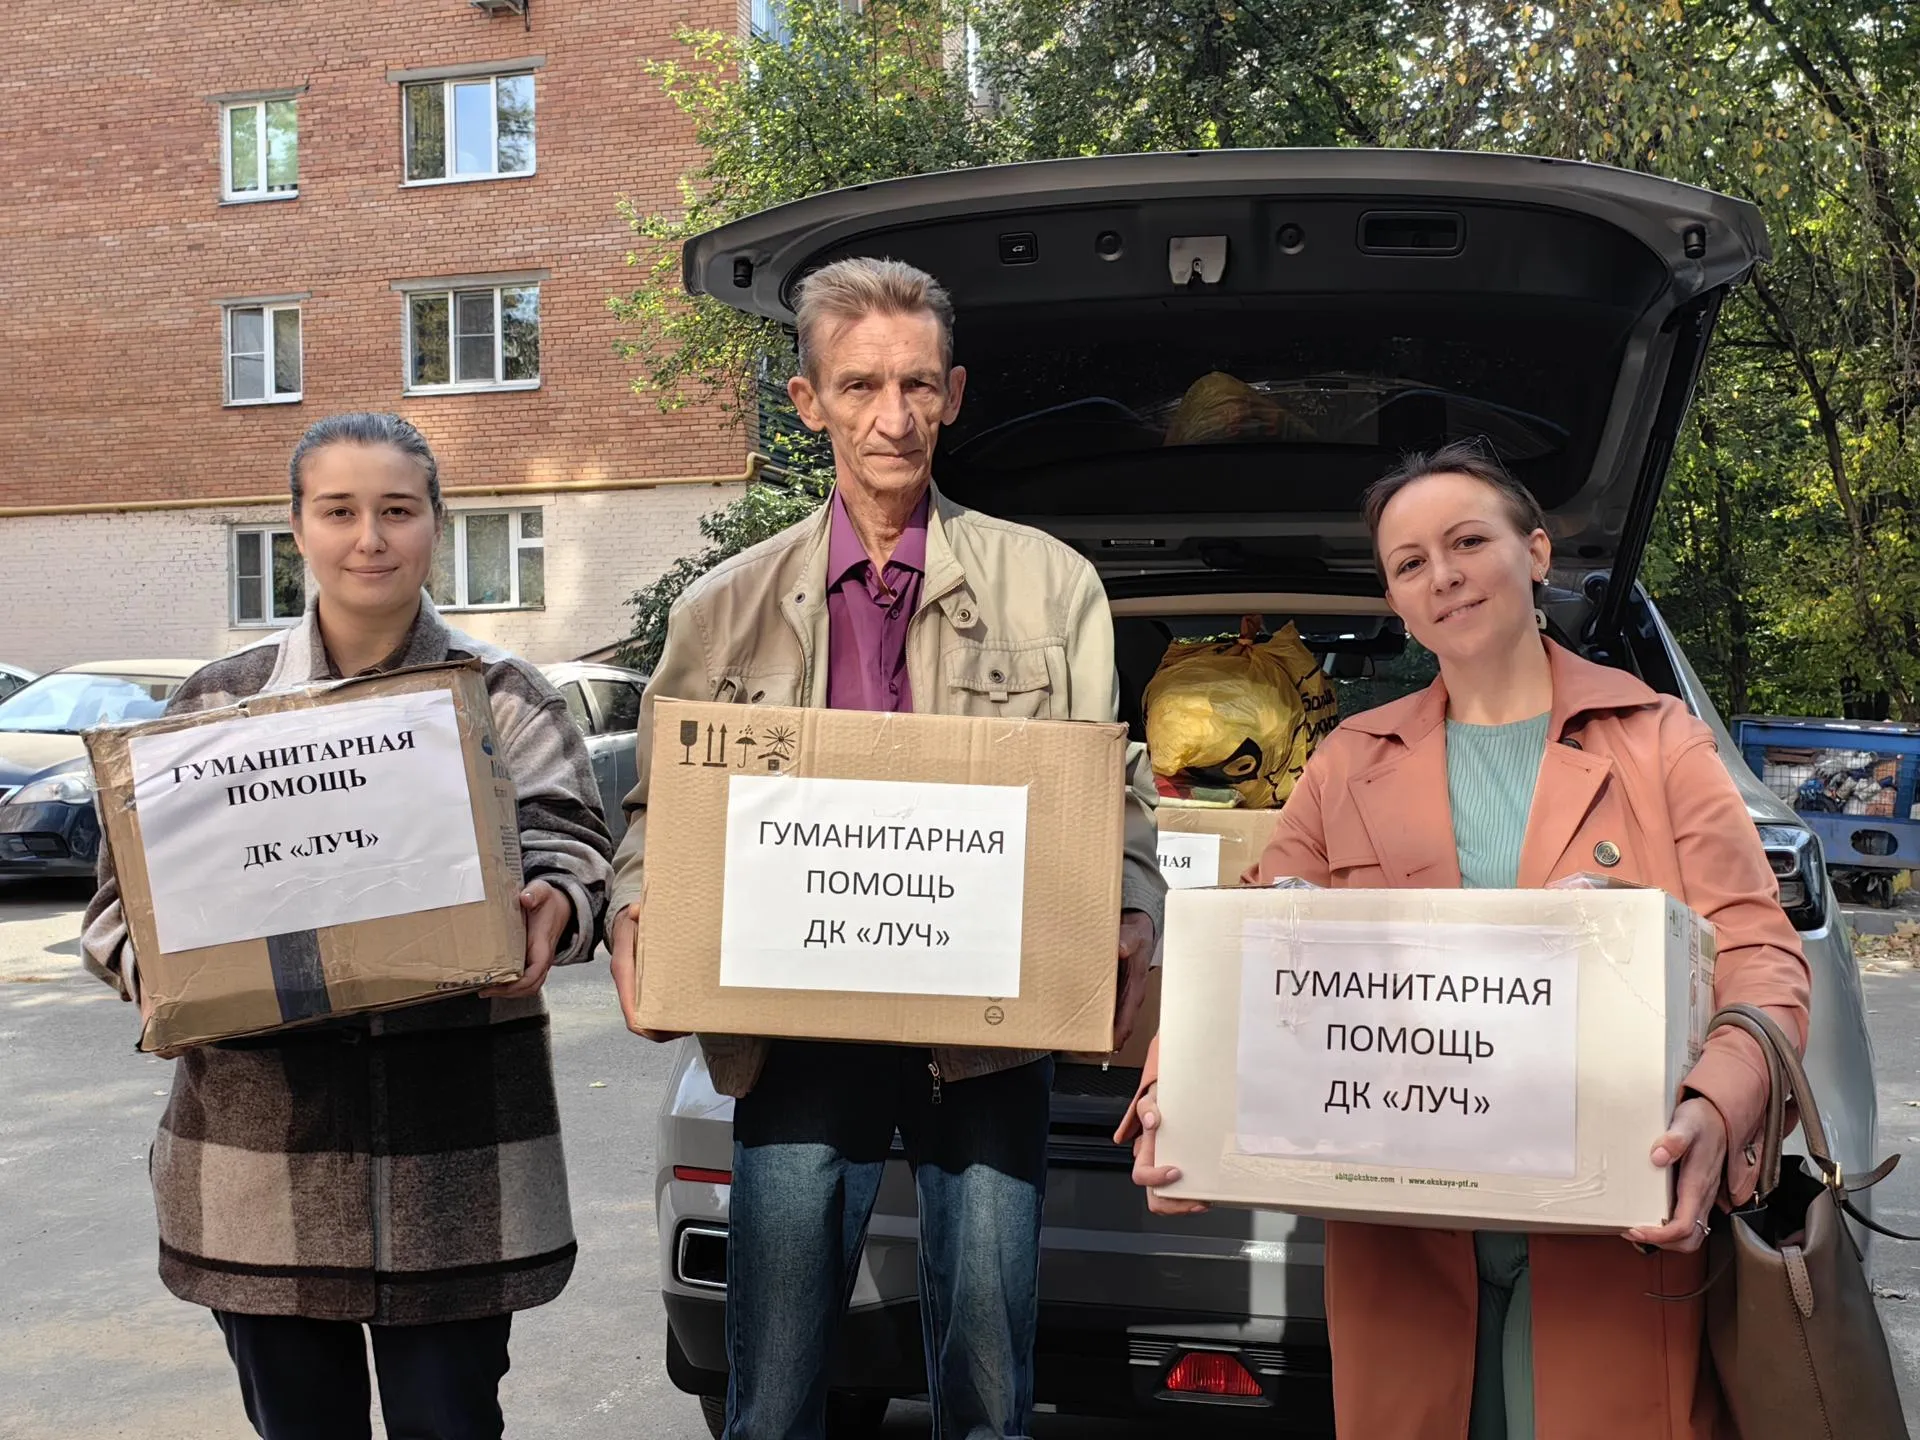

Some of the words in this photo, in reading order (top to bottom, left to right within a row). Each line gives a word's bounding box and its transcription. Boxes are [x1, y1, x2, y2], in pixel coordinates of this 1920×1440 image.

[172, 730, 415, 784] ГУМАНИТАРНАЯ
[226, 768, 367, 806] ПОМОЩЬ
[243, 841, 283, 870] ДК
[290, 829, 379, 858] «ЛУЧ»
[759, 821, 1004, 854] ГУМАНИТАРНАЯ
[806, 870, 955, 904] ПОМОЩЬ
[803, 919, 846, 949] ДК
[857, 922, 950, 948] «ЛУЧ»
[1275, 969, 1551, 1006] ГУМАНИТАРНАЯ
[1326, 1023, 1494, 1065] ПОМОЩЬ
[1324, 1080, 1371, 1115] ДК
[1382, 1085, 1490, 1117] «ЛУЧ»
